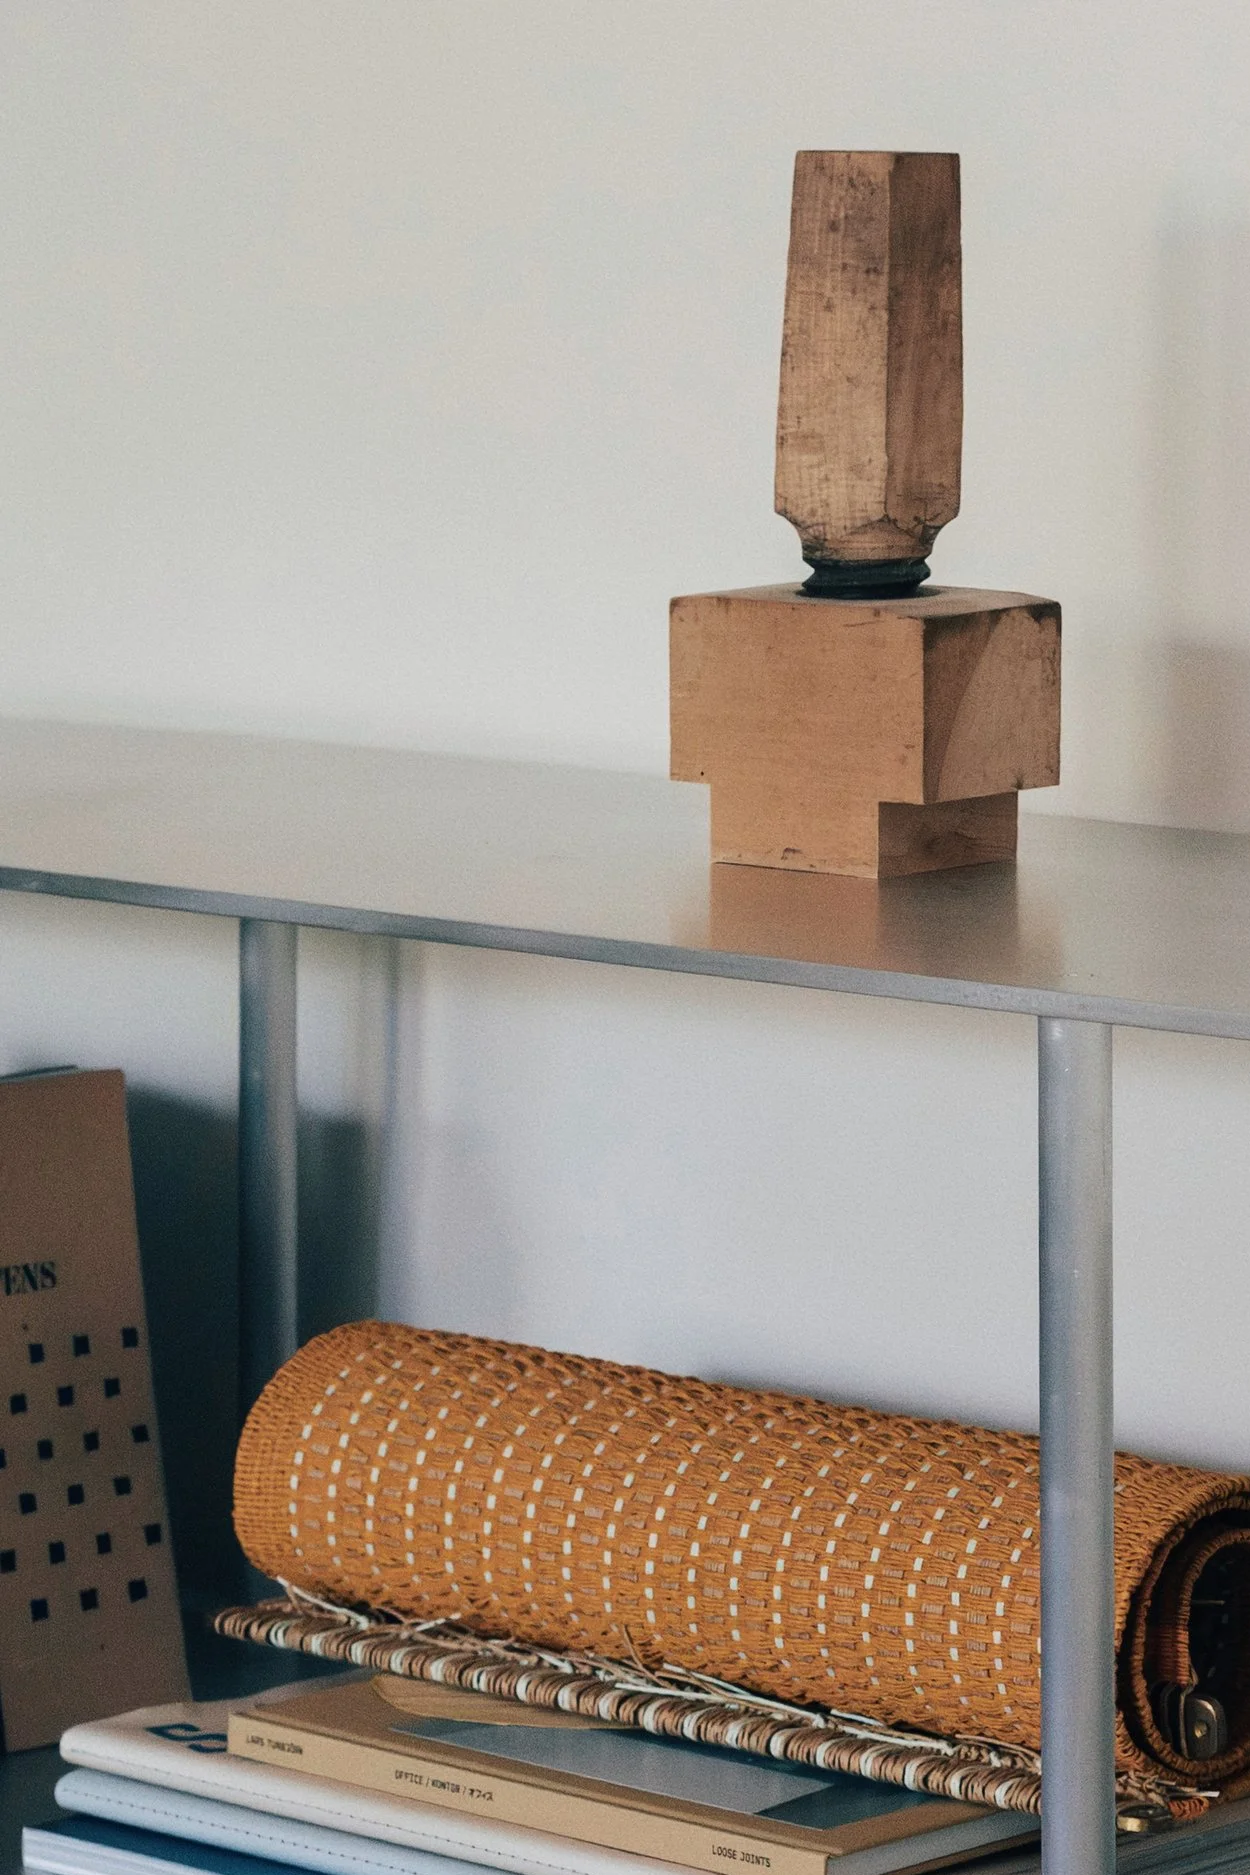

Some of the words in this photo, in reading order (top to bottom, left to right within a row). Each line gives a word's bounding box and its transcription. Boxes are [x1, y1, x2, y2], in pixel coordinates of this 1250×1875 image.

[394, 1769, 423, 1785] OFFICE
[712, 1844, 737, 1860] LOOSE
[740, 1852, 771, 1868] JOINTS
